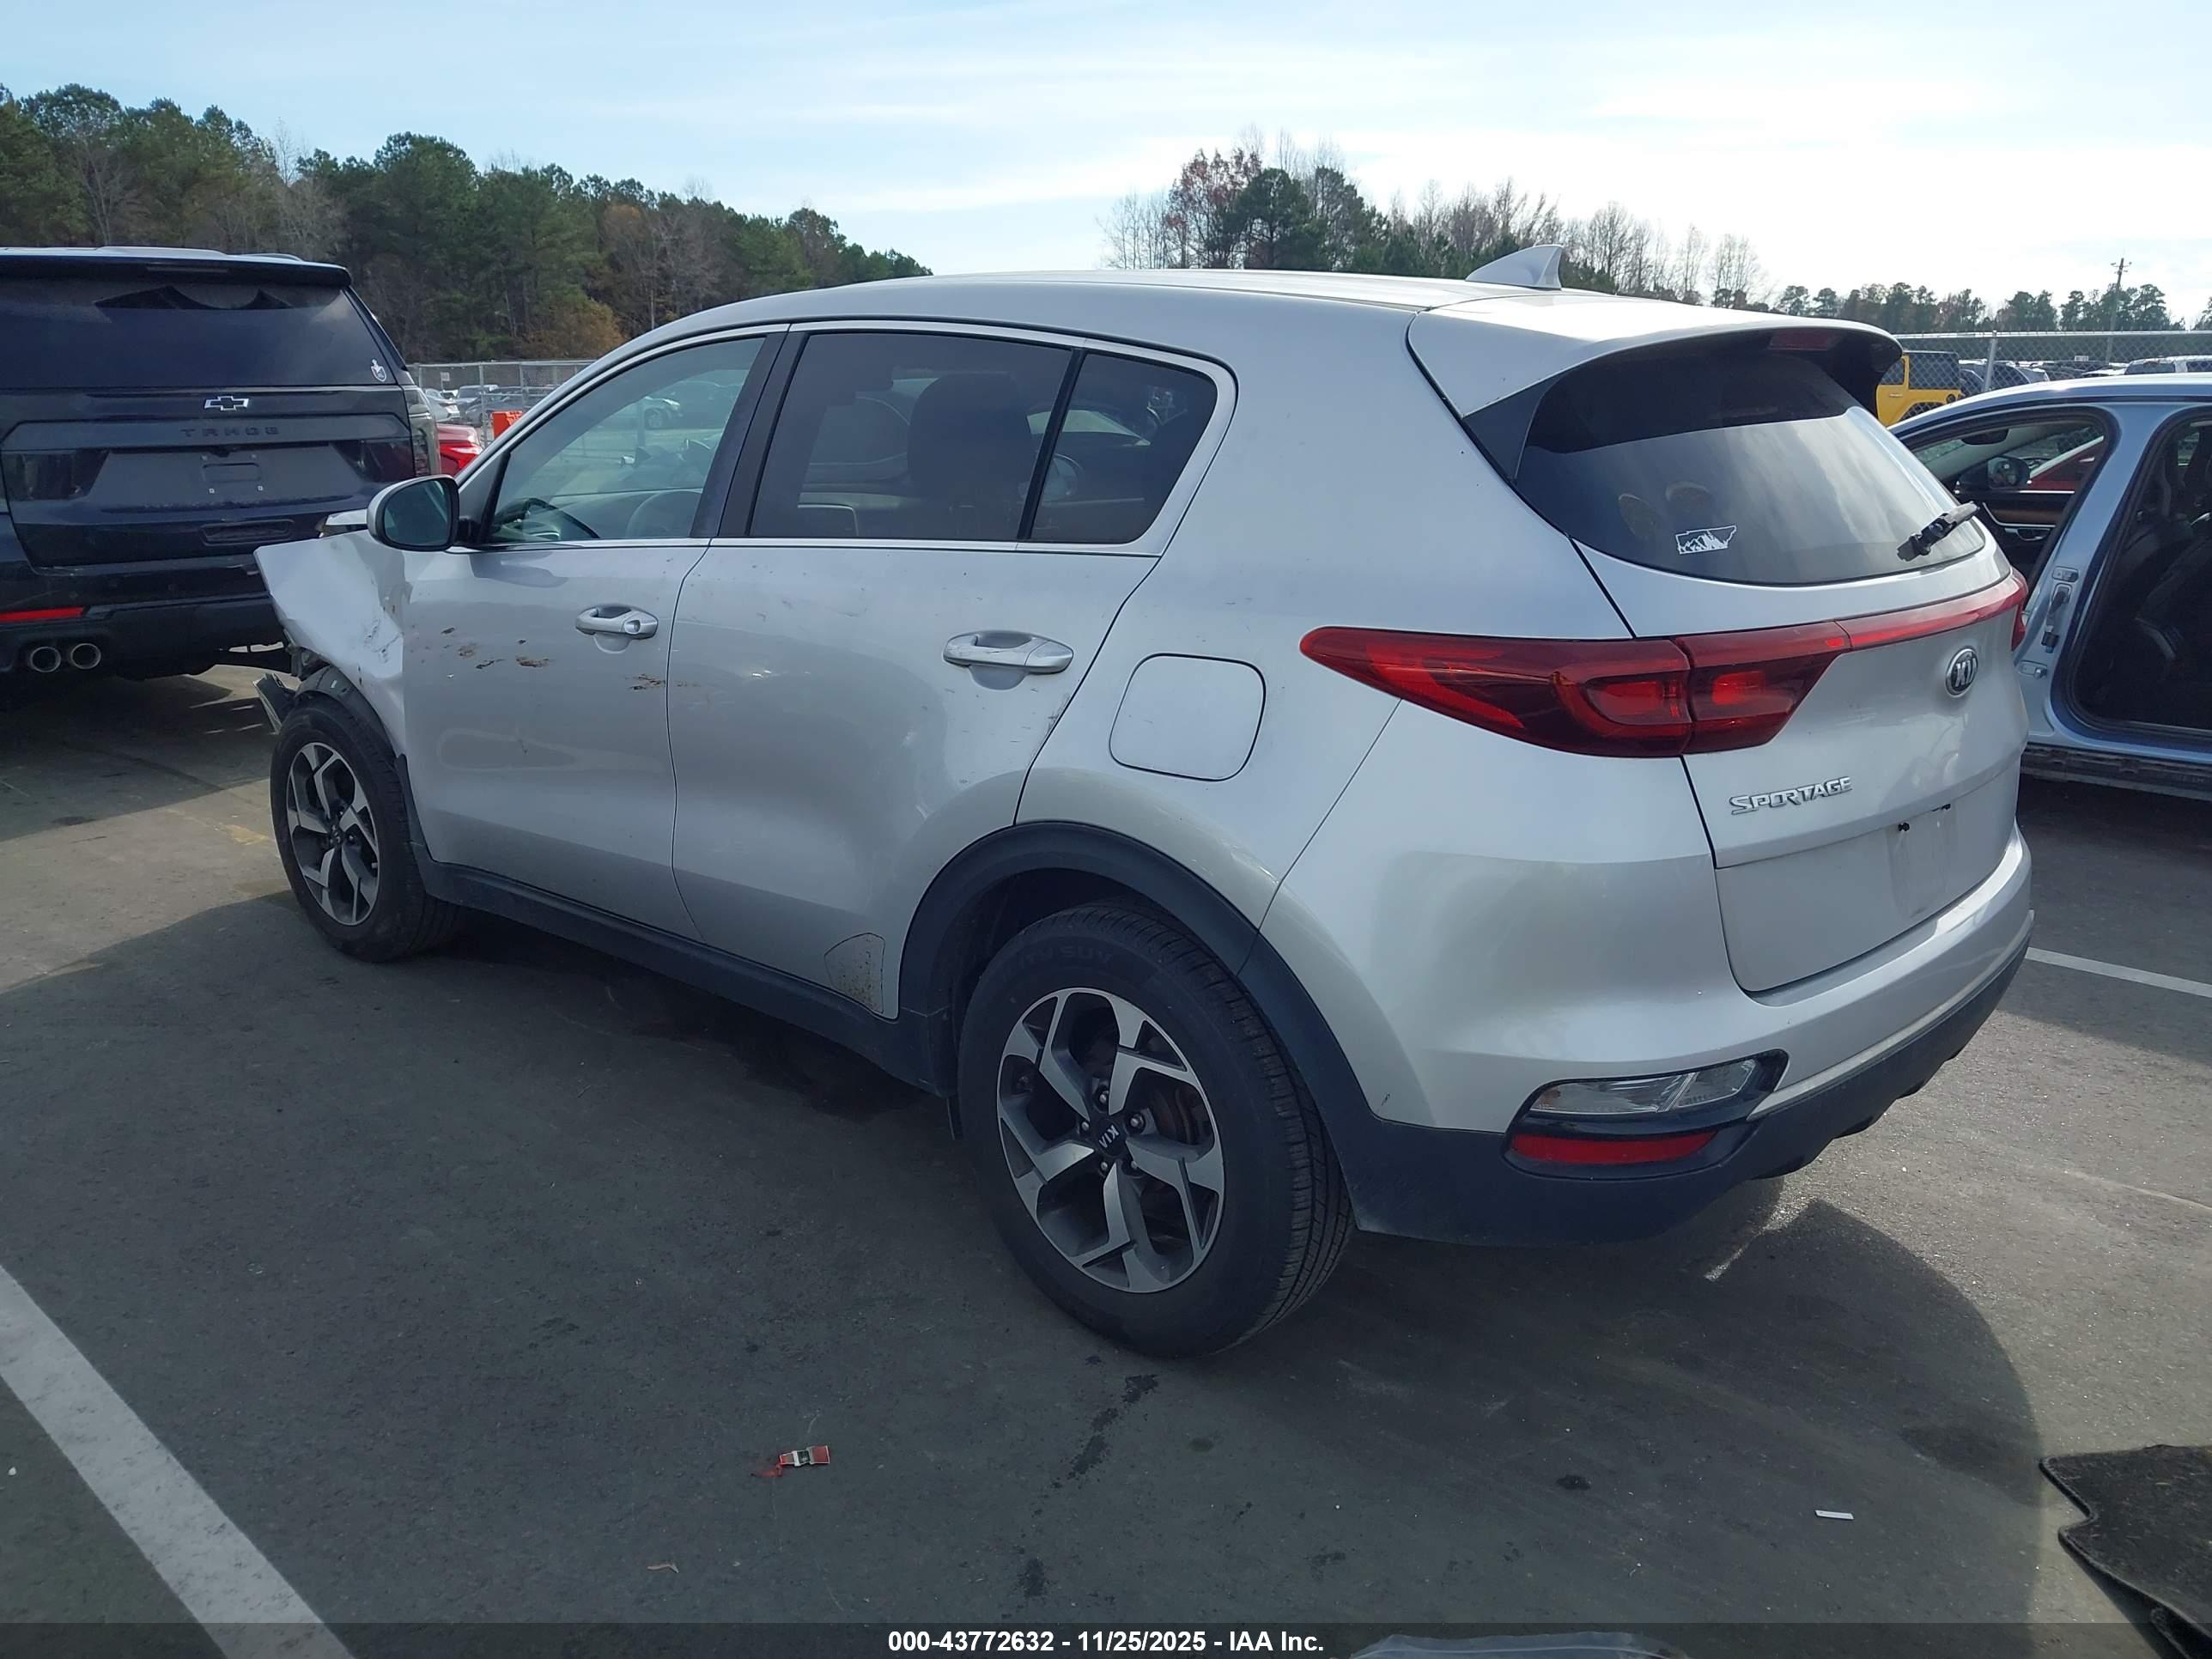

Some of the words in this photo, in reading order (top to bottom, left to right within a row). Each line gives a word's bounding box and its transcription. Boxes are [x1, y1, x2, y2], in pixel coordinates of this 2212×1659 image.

[179, 427, 279, 437] TAHOE
[1729, 776, 1852, 815] SPORTAGE
[1091, 1124, 1119, 1148] KIA
